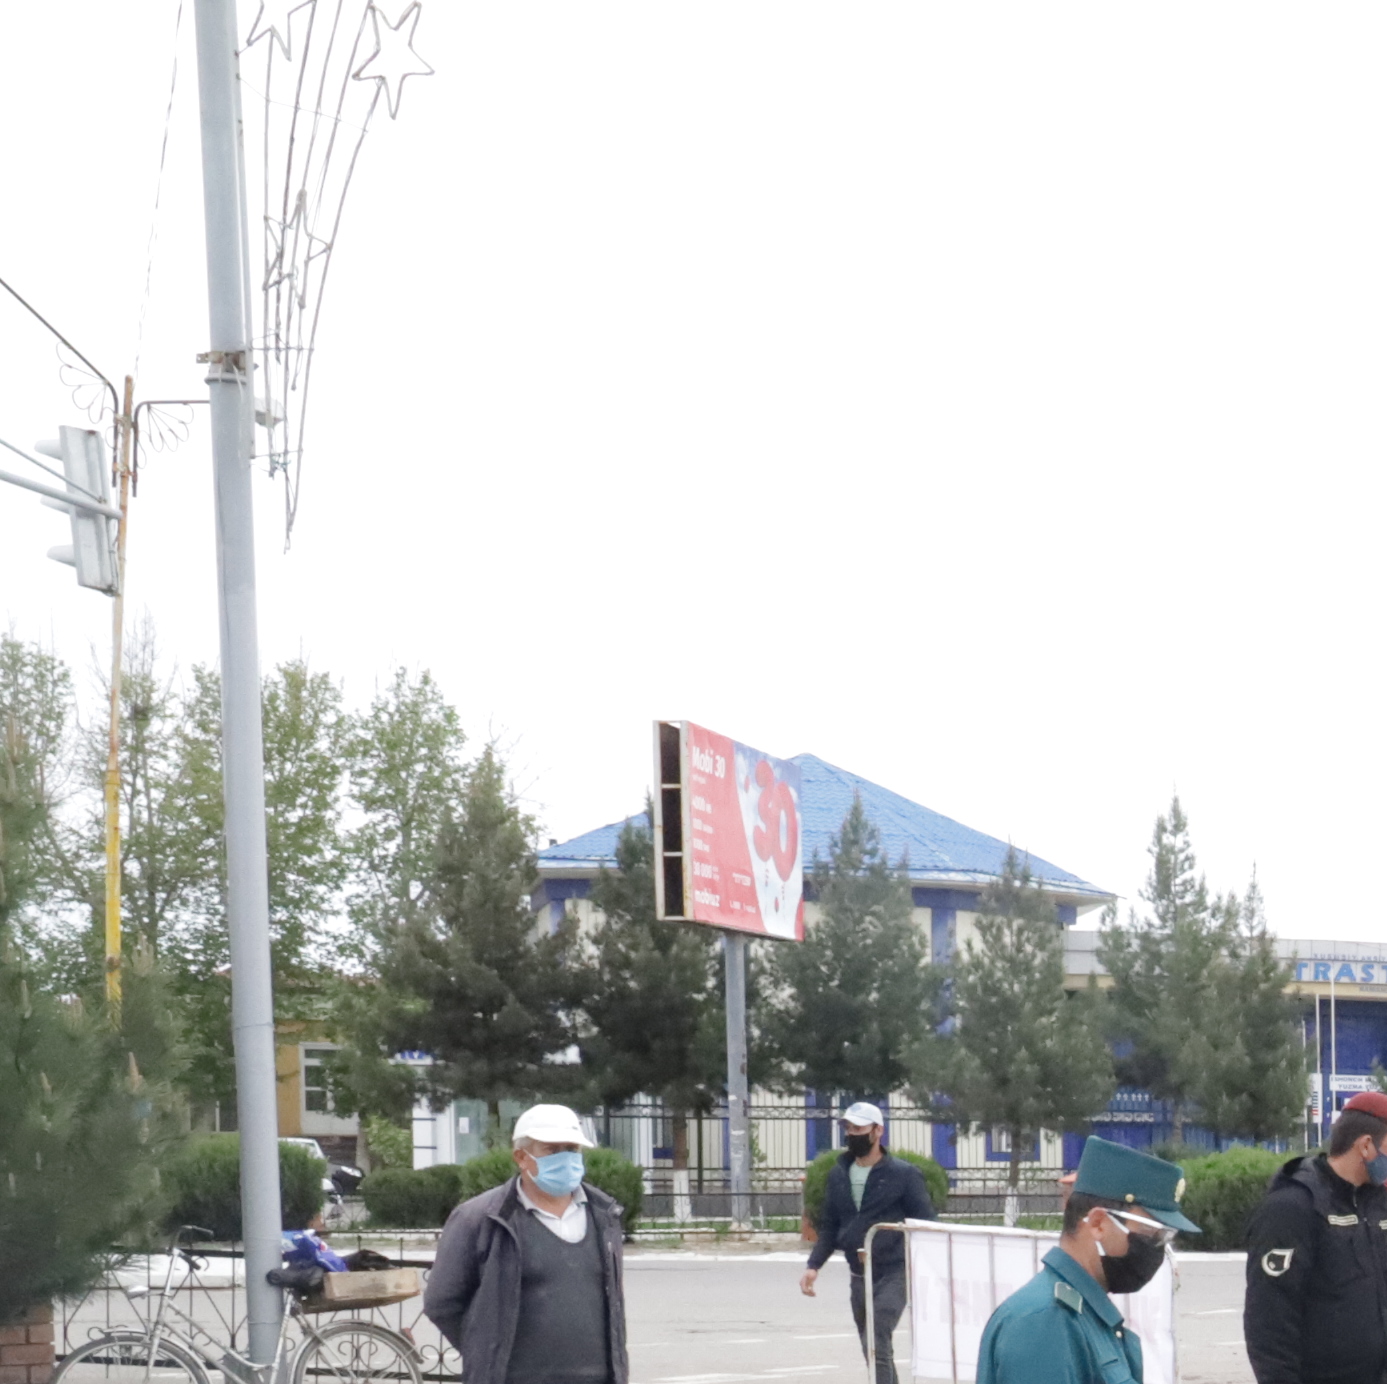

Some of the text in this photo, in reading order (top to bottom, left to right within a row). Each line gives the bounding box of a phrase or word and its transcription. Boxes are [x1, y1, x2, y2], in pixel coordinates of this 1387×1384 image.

[693, 746, 726, 779] Mobi 30
[753, 760, 798, 882] 30
